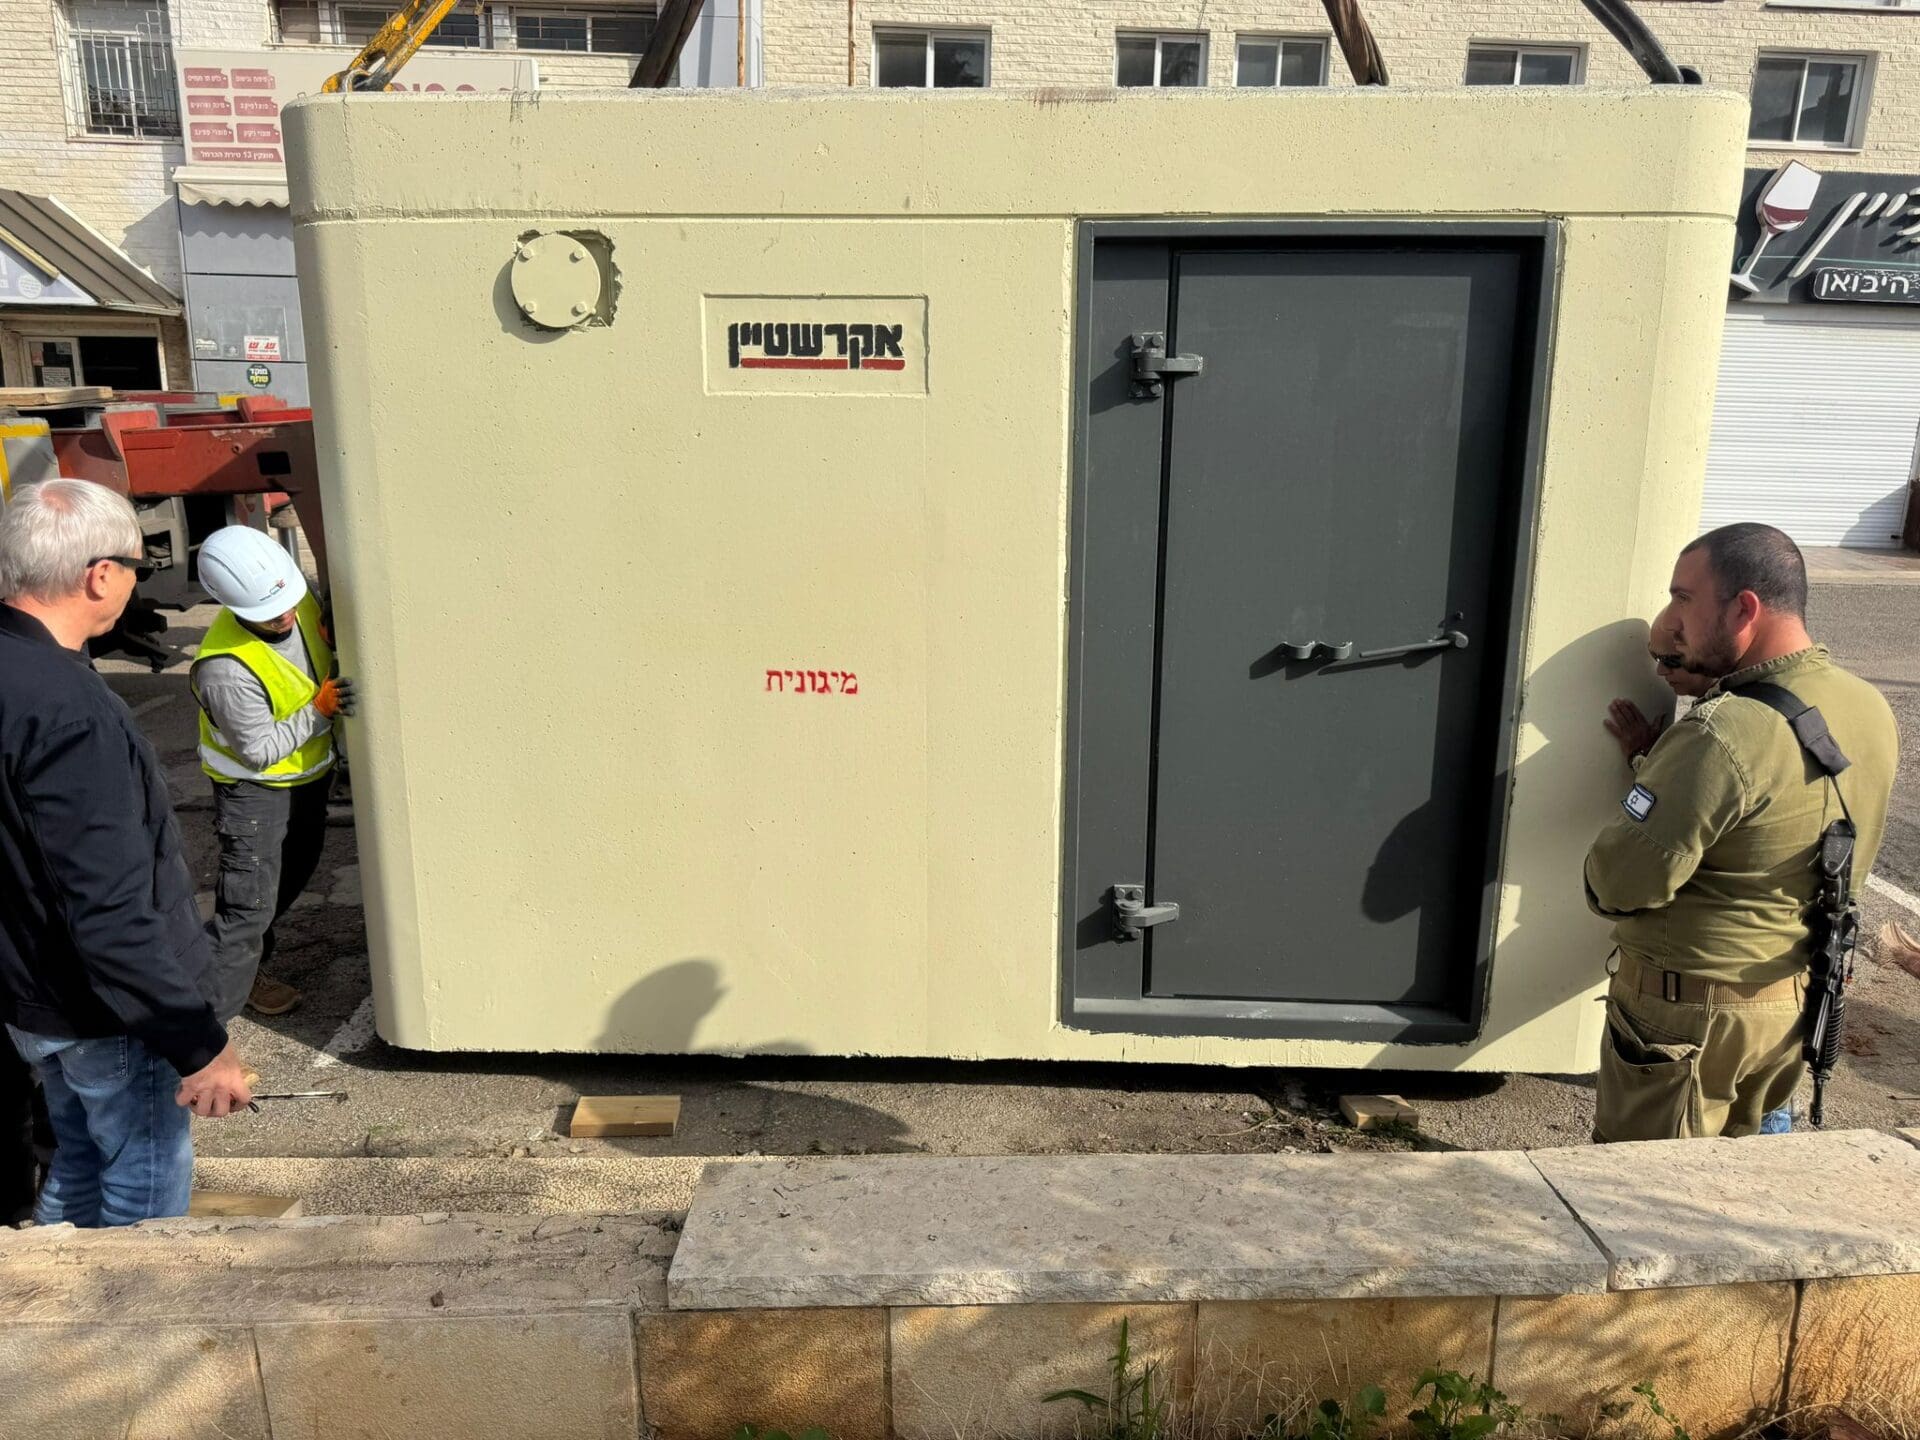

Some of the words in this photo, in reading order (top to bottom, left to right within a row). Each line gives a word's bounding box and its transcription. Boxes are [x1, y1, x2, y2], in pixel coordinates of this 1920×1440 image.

[253, 152, 274, 160] מוצקין
[1820, 273, 1909, 296] היבואן
[728, 322, 904, 369] אקרשטיין
[249, 368, 268, 376] מוקד
